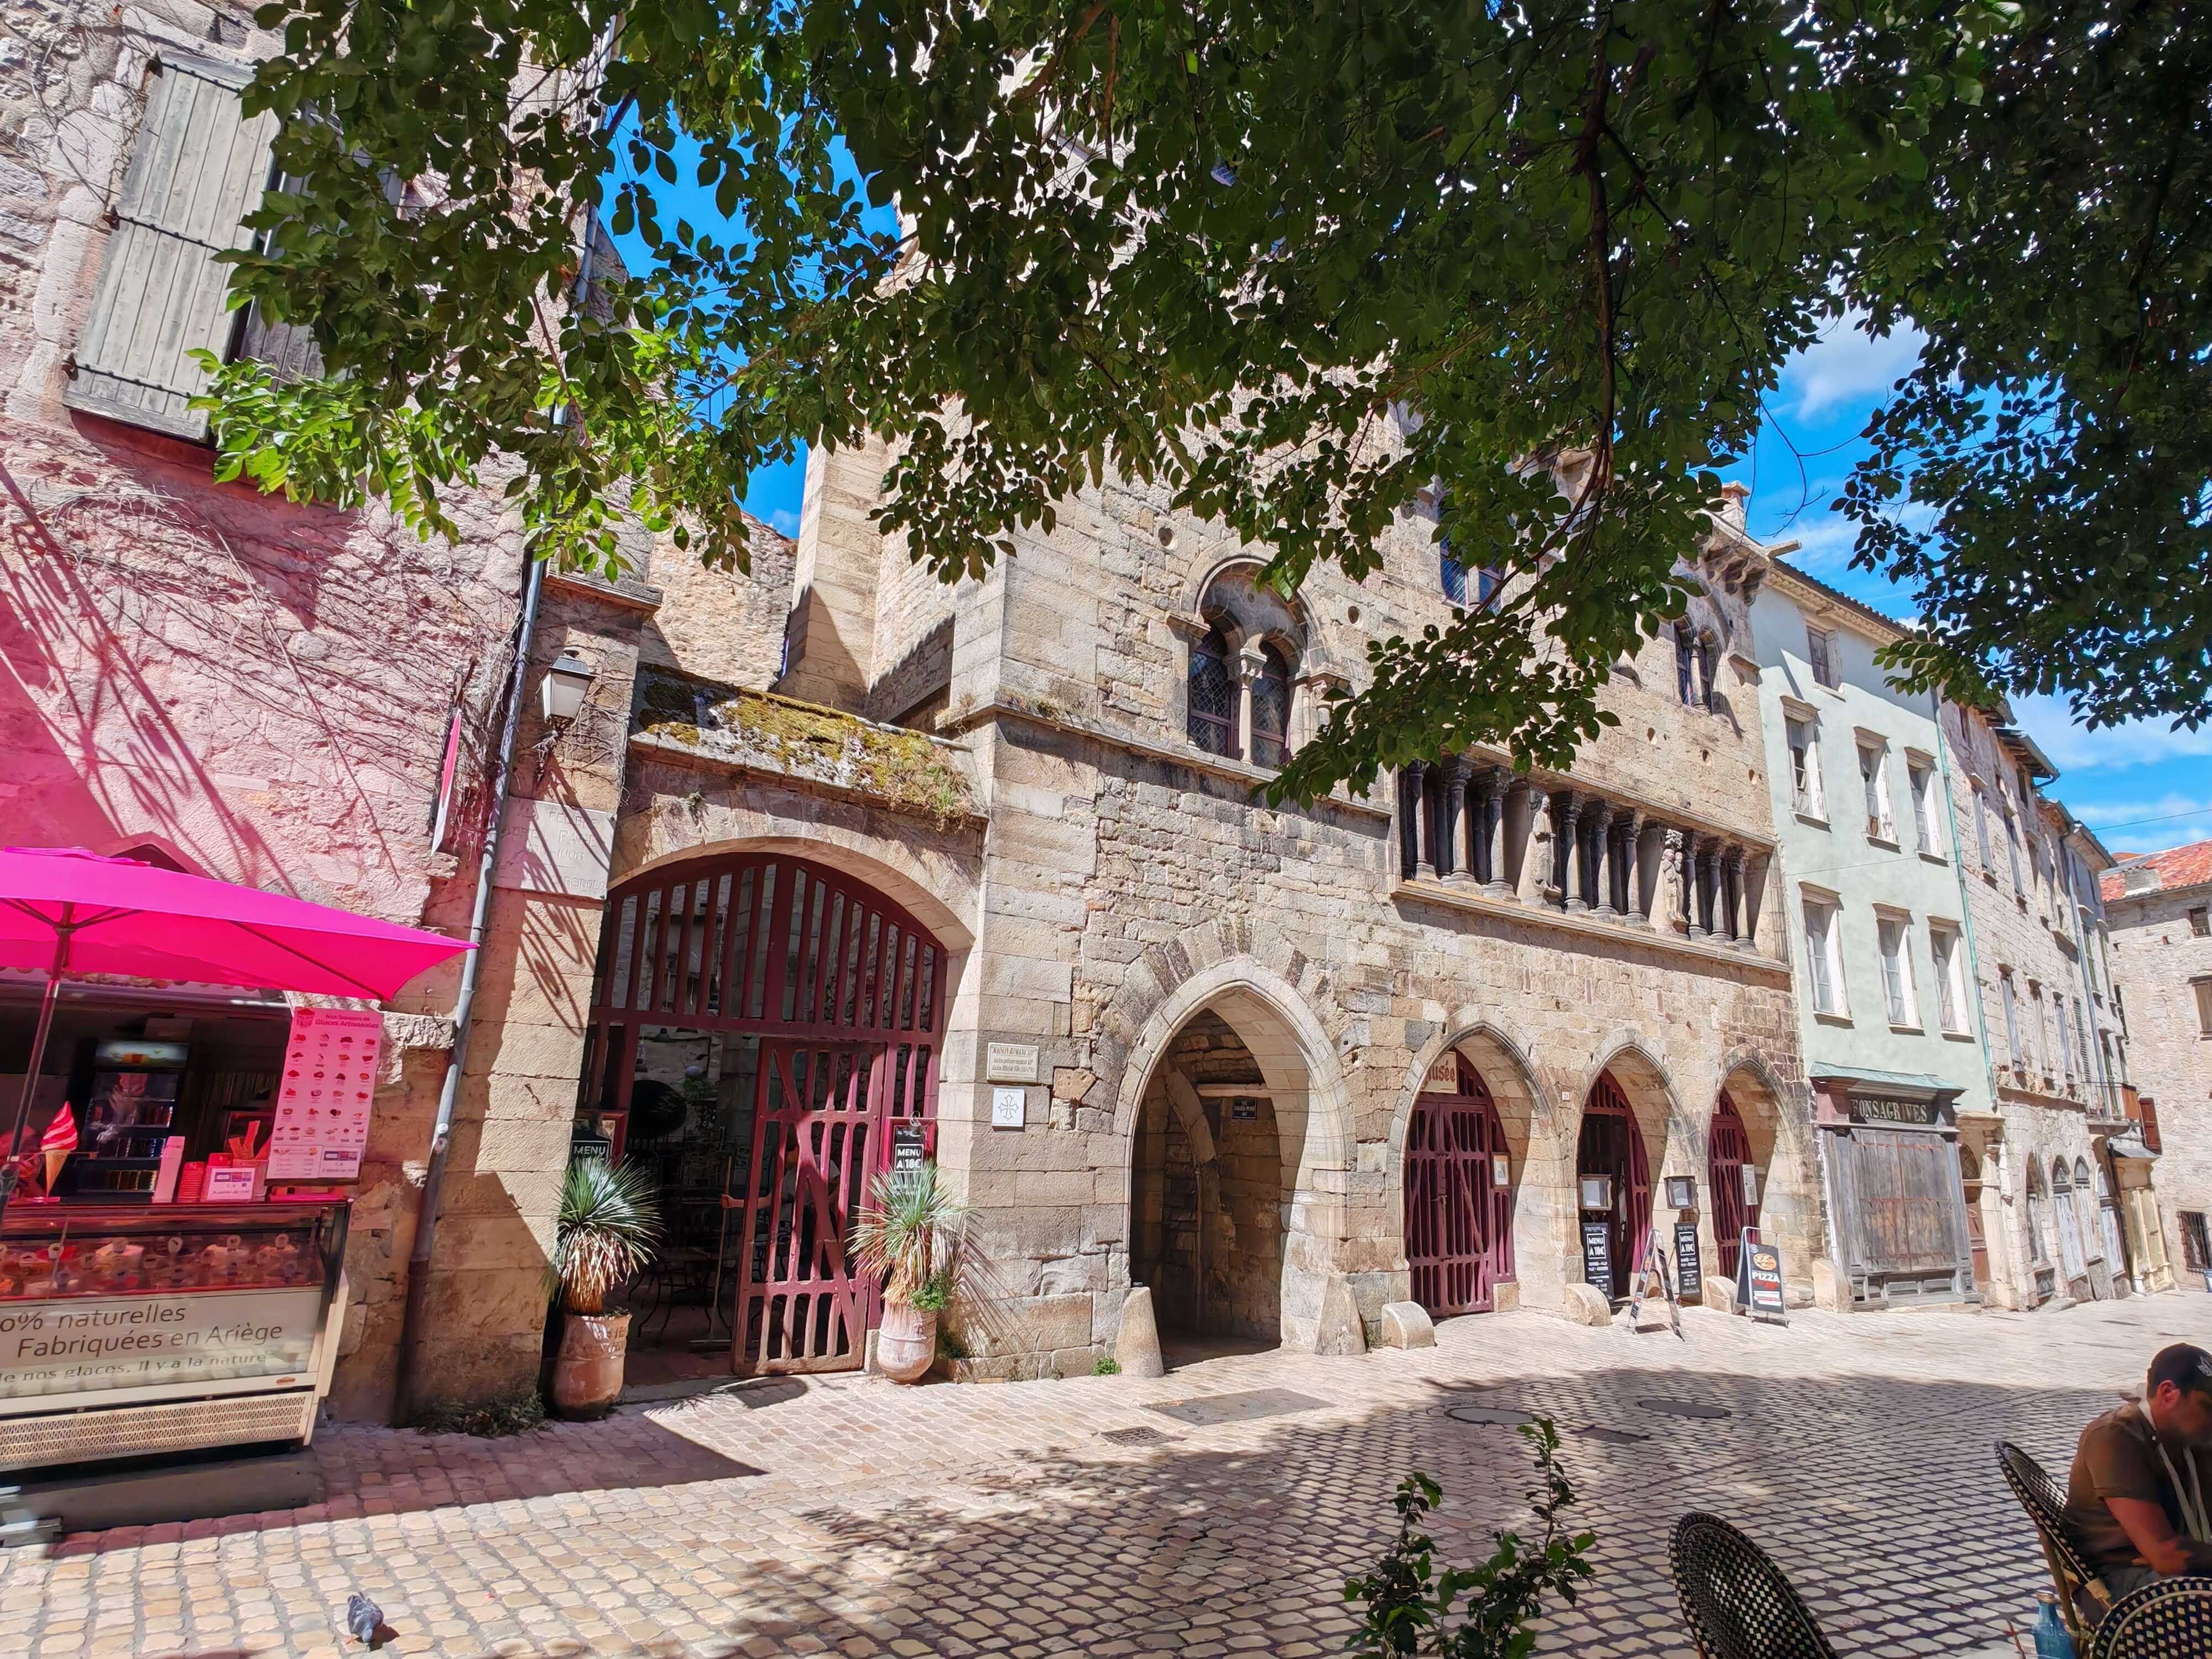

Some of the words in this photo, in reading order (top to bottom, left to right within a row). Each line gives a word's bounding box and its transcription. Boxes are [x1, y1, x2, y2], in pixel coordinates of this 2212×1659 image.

[573, 1145, 606, 1155] MENU
[1751, 1271, 1781, 1284] PIZZA
[58, 1303, 186, 1328] naturelles
[17, 1329, 163, 1358] Fabriquées
[170, 1332, 200, 1347] en
[205, 1322, 283, 1345] Ariège
[22, 1369, 57, 1382] nos
[156, 1362, 165, 1371] y
[170, 1360, 181, 1369] a
[189, 1357, 202, 1368] la
[210, 1353, 267, 1365] nature
